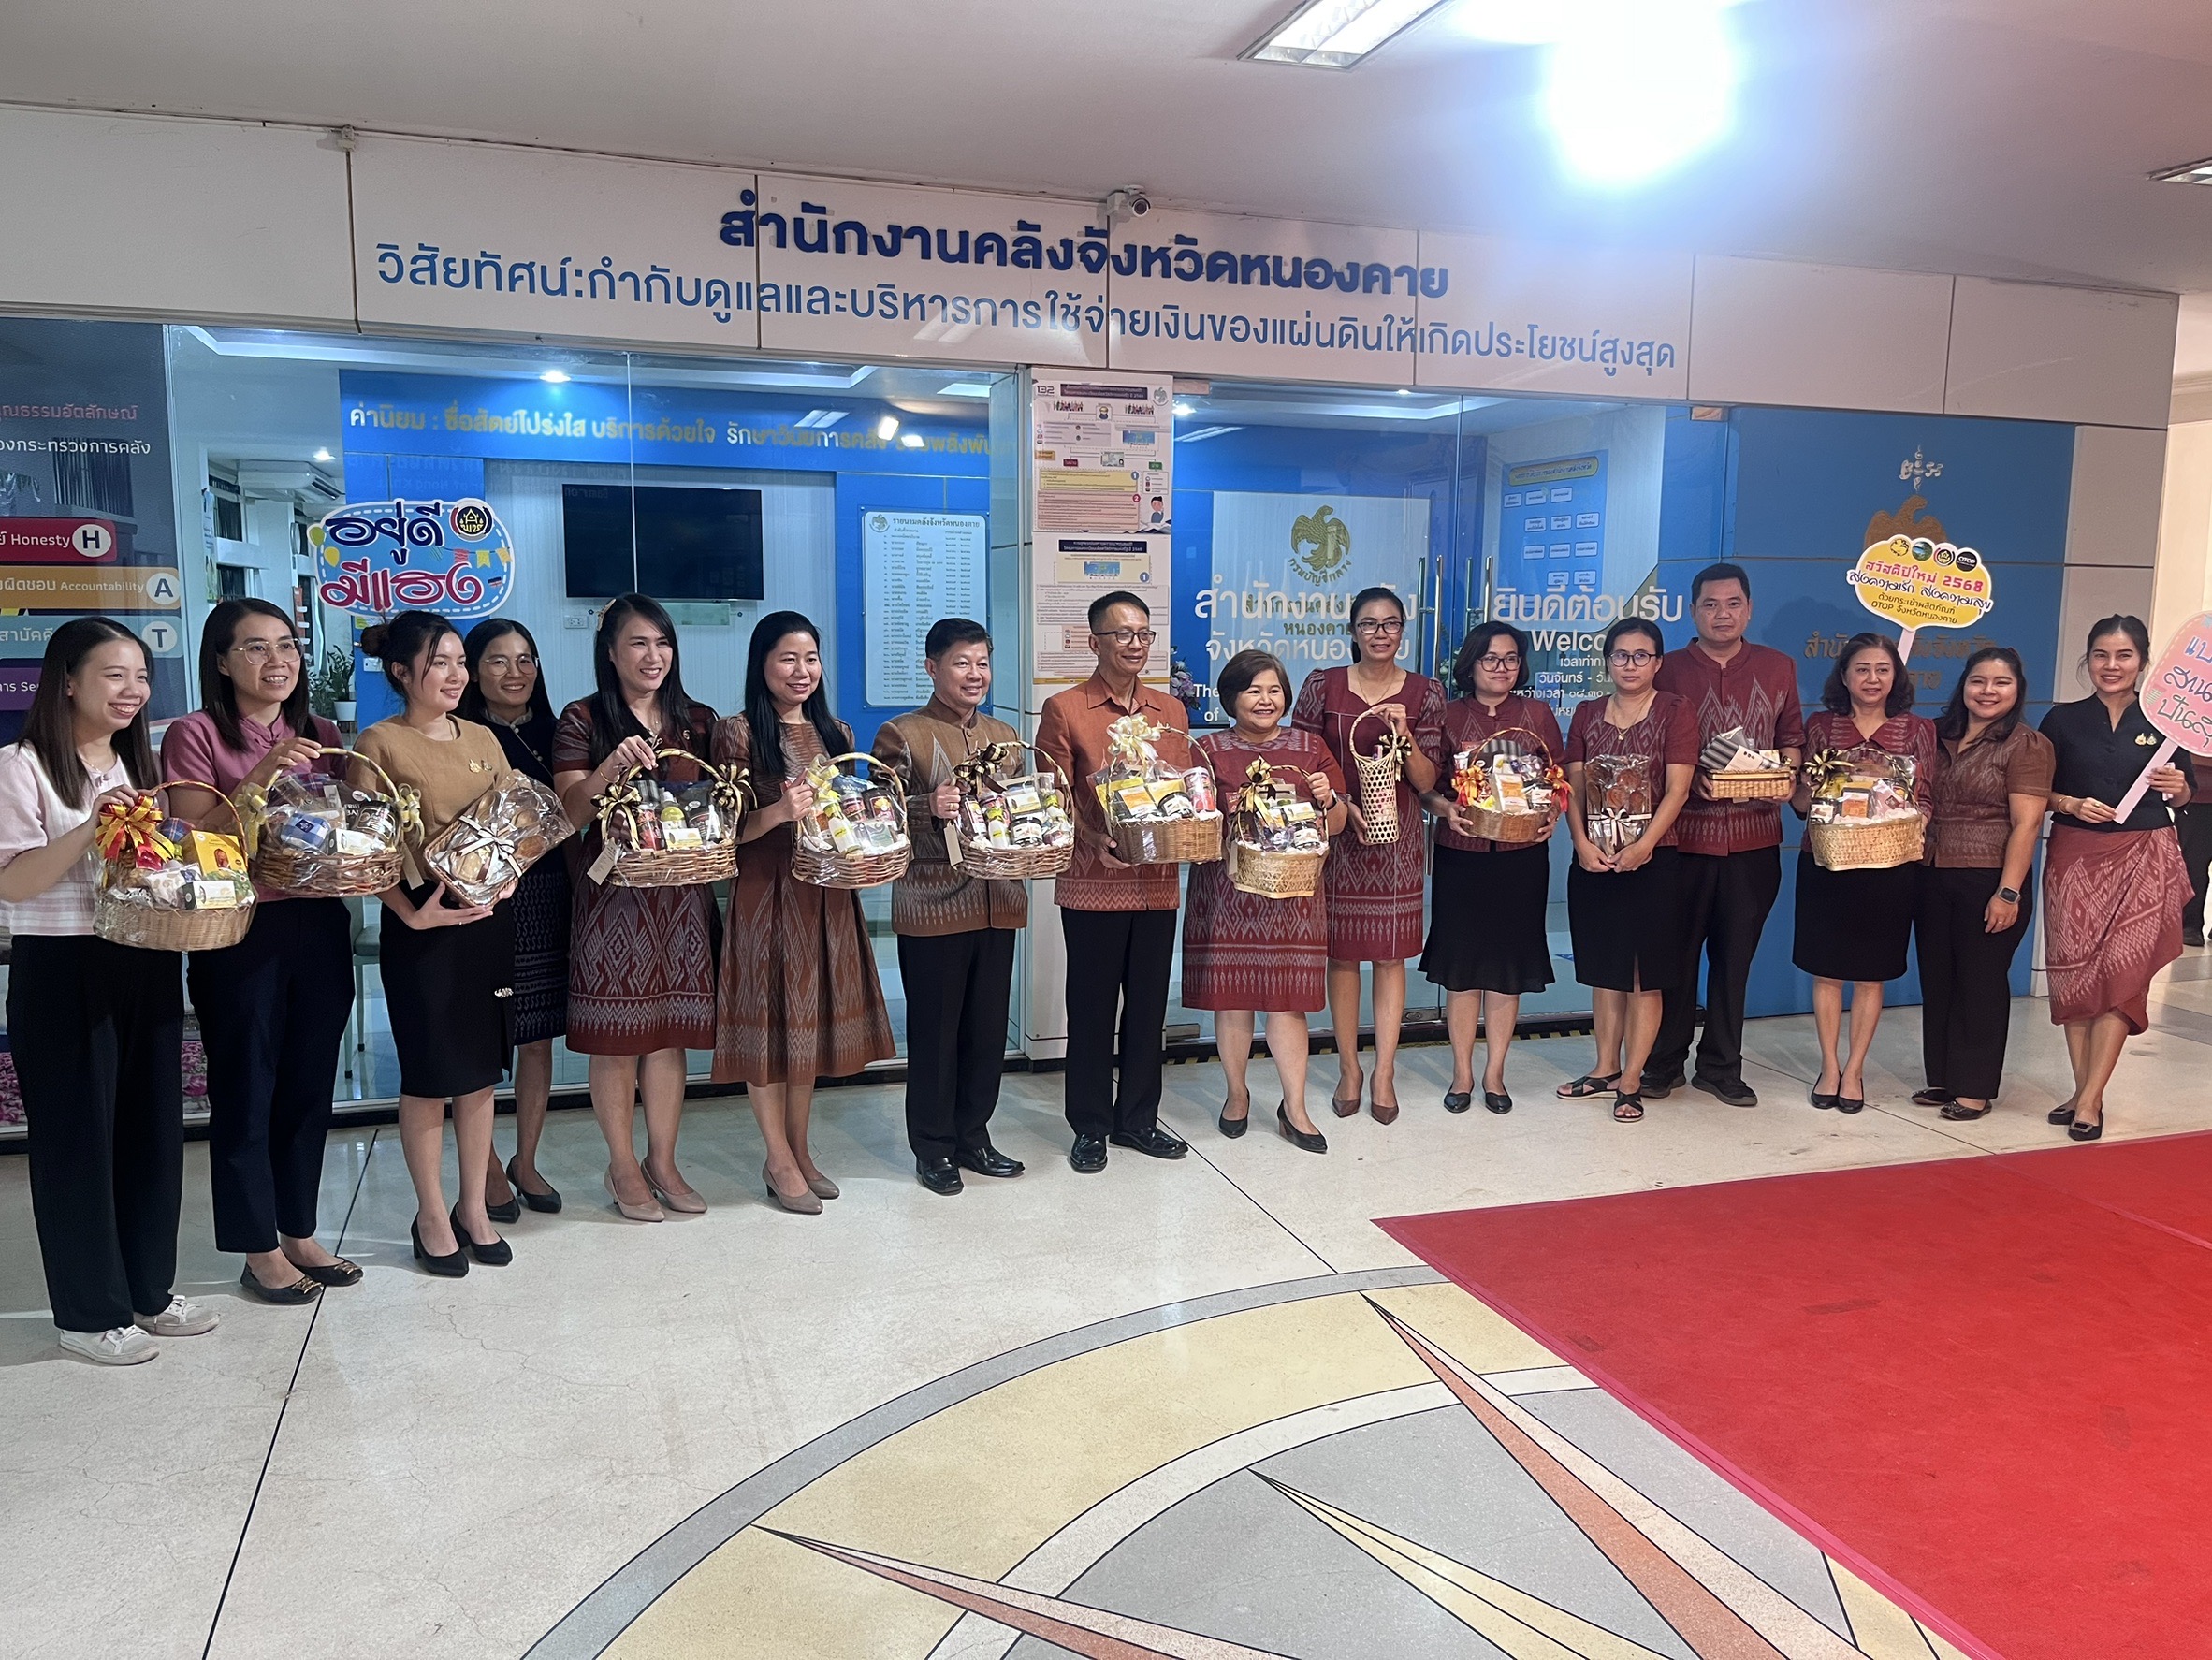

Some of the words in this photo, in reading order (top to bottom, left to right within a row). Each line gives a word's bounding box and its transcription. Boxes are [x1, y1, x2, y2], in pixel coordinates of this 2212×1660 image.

[720, 190, 1449, 299] สำนักงานคลังจังหวัดหนองคาย
[0, 403, 139, 421] ณธรรมอัตลักษณ์
[350, 400, 425, 430] ค่านิยม
[591, 416, 716, 444] บริการด้วยใจ
[11, 533, 71, 548] Honesty
[82, 529, 100, 549] H
[325, 501, 445, 565] อยู่ดี
[1288, 557, 1352, 587] กรมบัญชีกลาง
[1865, 560, 1938, 584] สวัสดีปีใหม่
[1942, 575, 1984, 593] 2568
[60, 580, 144, 595] Accountability
[154, 577, 174, 598] A
[1194, 574, 1417, 620] สำนักงานัง
[1492, 584, 1683, 623] ยินดีต้อนรับ
[1871, 600, 1895, 611] OTOP
[1531, 627, 1607, 652] Welco
[21, 681, 40, 692] Se
[1539, 670, 1584, 684] วันจันทร์
[1595, 671, 1613, 683] วัน
